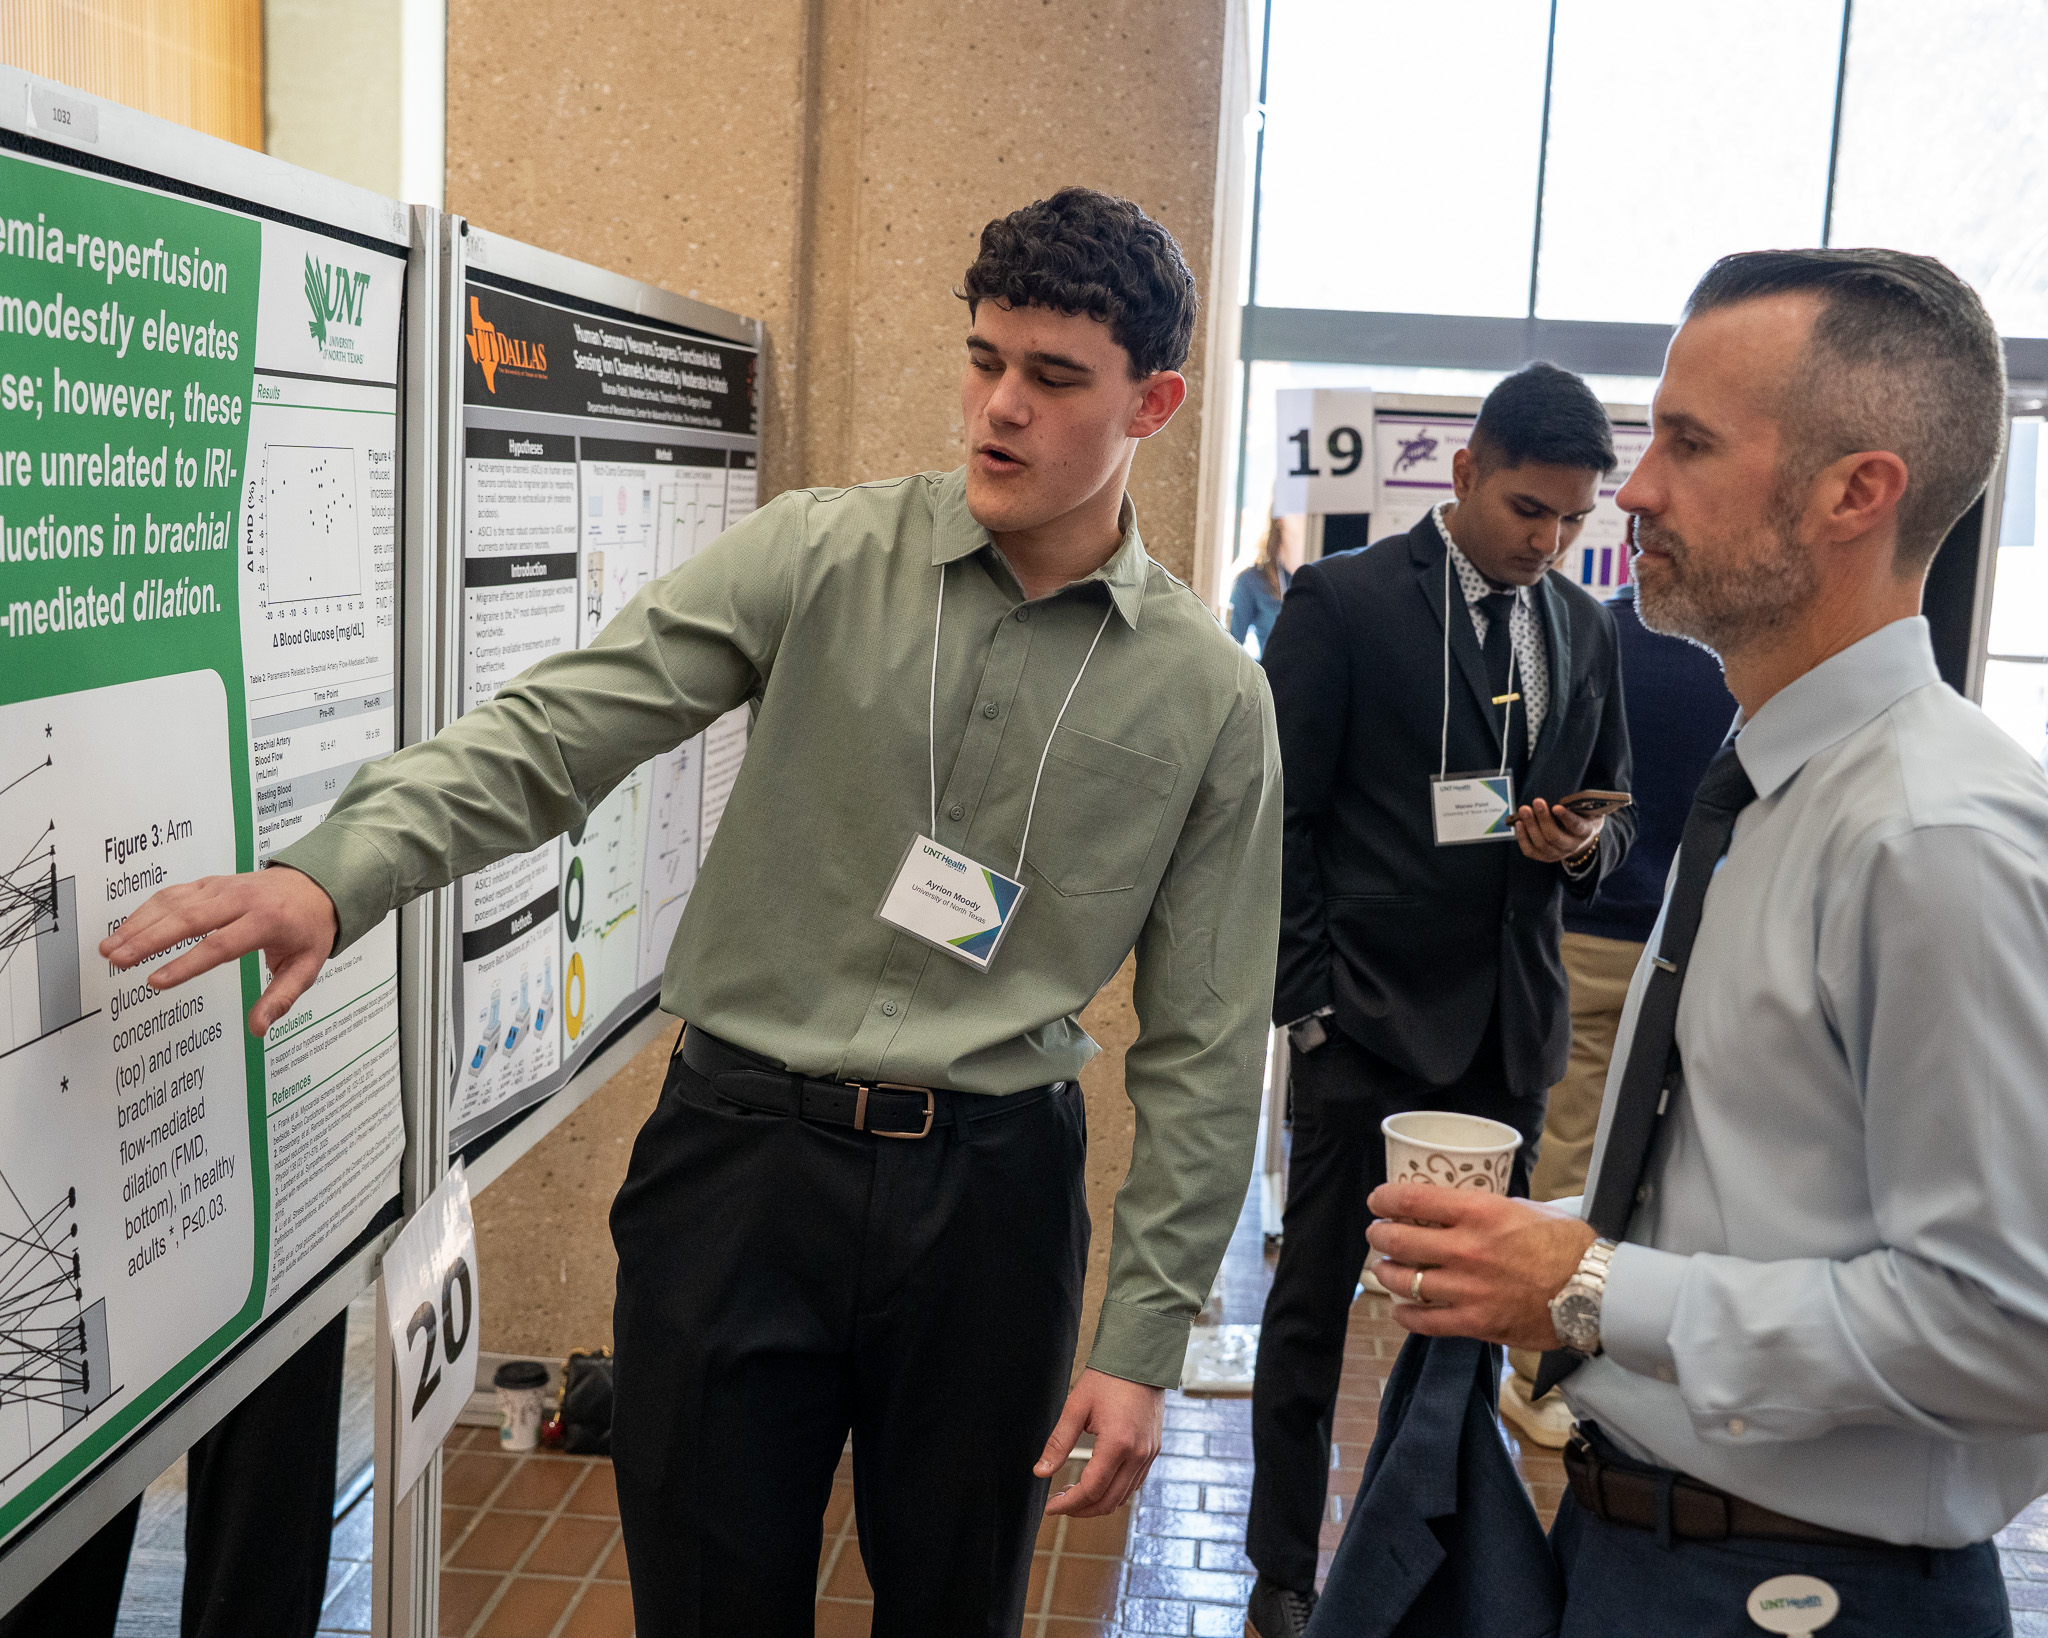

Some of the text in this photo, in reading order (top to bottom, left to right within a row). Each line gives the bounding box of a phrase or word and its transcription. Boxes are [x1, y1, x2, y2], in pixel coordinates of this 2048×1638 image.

[53, 107, 71, 126] 1032
[325, 263, 371, 326] UNT
[0, 293, 238, 361] modestly elevates
[328, 350, 346, 362] NORTH
[347, 353, 363, 364] TEXAS
[329, 336, 354, 350] UNIVERSITY
[474, 328, 547, 371] UT DALLAS
[53, 366, 174, 428] however,
[183, 381, 242, 425] these
[257, 384, 280, 399] Results
[368, 450, 387, 464] Figure
[509, 439, 543, 457] Hypotheses
[1288, 426, 1364, 479] 19
[41, 443, 168, 487] unrelated
[174, 453, 198, 488] to
[203, 447, 237, 488] IRI-
[0, 511, 231, 562] uctions in brachial
[511, 562, 547, 578] Introduction
[0, 577, 221, 638] -mediated dilation.
[476, 592, 499, 605] Migraine
[476, 612, 499, 624] Migraine
[280, 630, 301, 646] Blood
[304, 628, 334, 643] Glucose
[336, 622, 364, 642] [mg/dL]
[250, 658, 365, 684] Table Parameters Related Brachial Artery Flow-Mediated
[314, 690, 338, 701] Time Point
[320, 697, 380, 718] Pre-IRI Post-IRI
[254, 736, 291, 752] Brachial Artery
[255, 752, 283, 766] Blood Flow
[257, 783, 292, 801] Resting Blood
[258, 797, 293, 815] Velocity (cm/s)
[259, 814, 302, 835] Baseline Diameter
[105, 820, 192, 864] Figure 3: Arm
[259, 838, 270, 851] (cm)
[923, 845, 942, 859] UNT
[941, 855, 967, 872] Health
[107, 863, 167, 901] ischemia-
[926, 880, 981, 911] Ayrion Moody
[912, 884, 942, 903] University
[950, 903, 967, 915] North
[969, 911, 986, 924] Texas
[113, 995, 204, 1052] concentrations
[269, 1010, 312, 1041] Conclusions
[116, 1022, 222, 1096] (top) and reduces
[118, 1066, 204, 1128] brachial artery
[272, 1075, 311, 1107] References
[120, 1096, 205, 1165] flow-mediated
[123, 1134, 208, 1202] dilation (FMD,
[125, 1155, 235, 1240] bottom), in healthy
[128, 1237, 166, 1277] adults
[406, 1256, 472, 1423] 20
